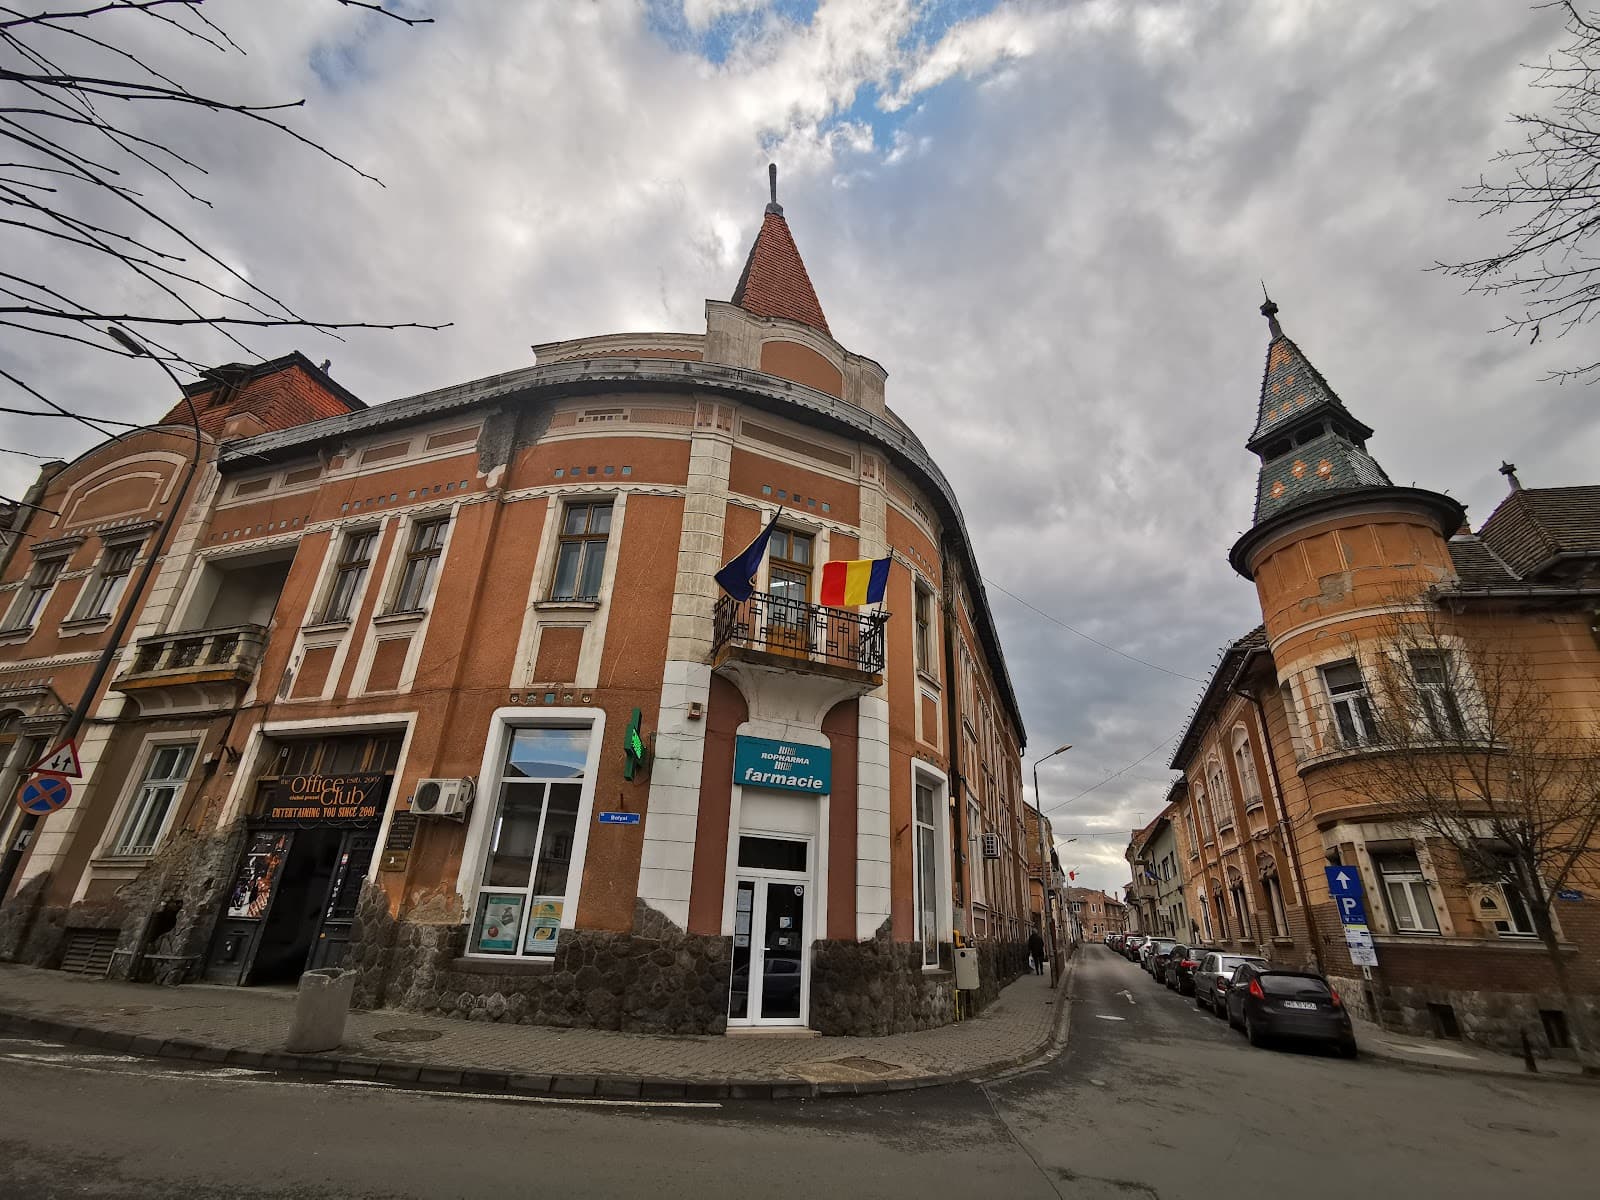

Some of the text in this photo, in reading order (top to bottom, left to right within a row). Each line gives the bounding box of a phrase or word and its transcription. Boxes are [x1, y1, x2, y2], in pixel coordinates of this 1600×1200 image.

[761, 752, 809, 765] ROPHARMA
[291, 775, 345, 793] Office
[745, 767, 823, 789] farmacie
[320, 786, 364, 806] Club
[272, 806, 376, 818] ENTERTAINING YOU SINCE 2001
[1342, 897, 1357, 915] P
